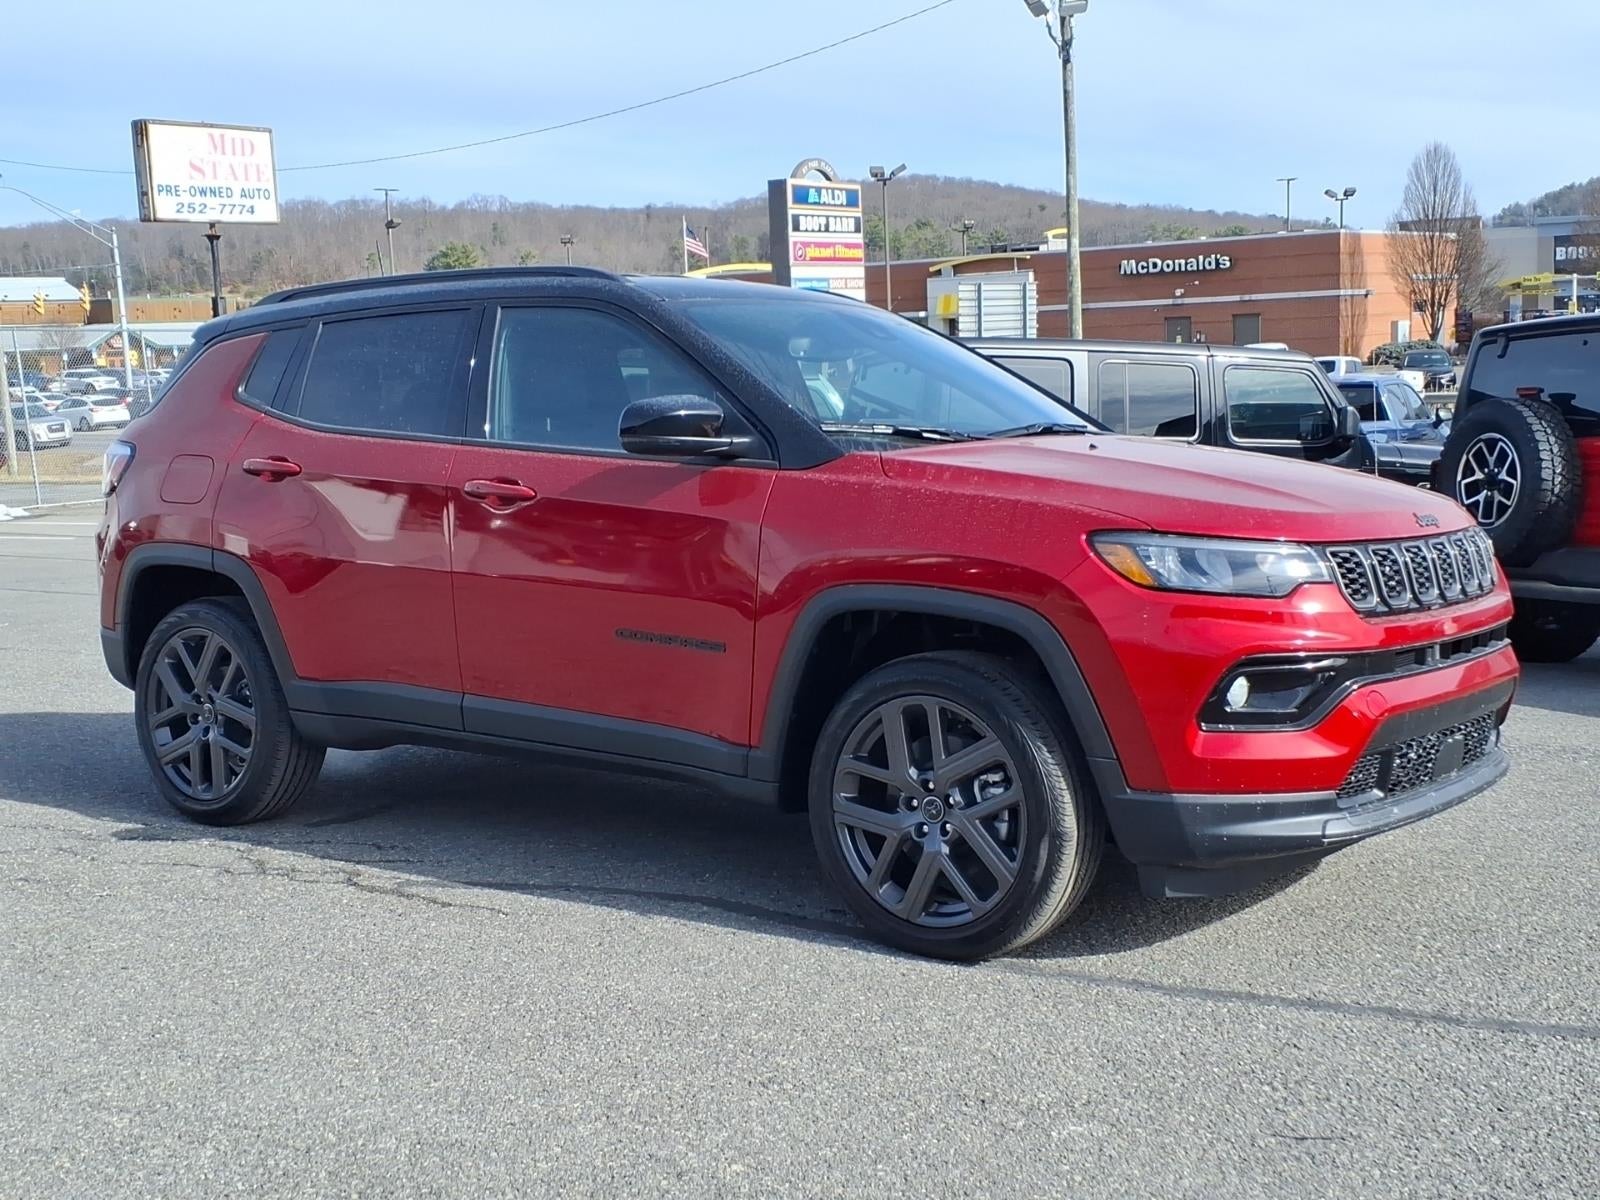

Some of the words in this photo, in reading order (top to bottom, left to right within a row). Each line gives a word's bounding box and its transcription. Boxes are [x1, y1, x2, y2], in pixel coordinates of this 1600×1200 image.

[208, 132, 255, 157] MID
[188, 157, 270, 183] STATE
[157, 184, 234, 199] PRE-OWNED
[240, 188, 271, 200] AUTO
[820, 188, 847, 206] ALDI
[175, 202, 256, 216] 252-7774
[799, 215, 827, 232] BOOT
[828, 216, 855, 232] BARN
[1120, 253, 1231, 275] McDonald's
[615, 628, 726, 653] COMPASS
